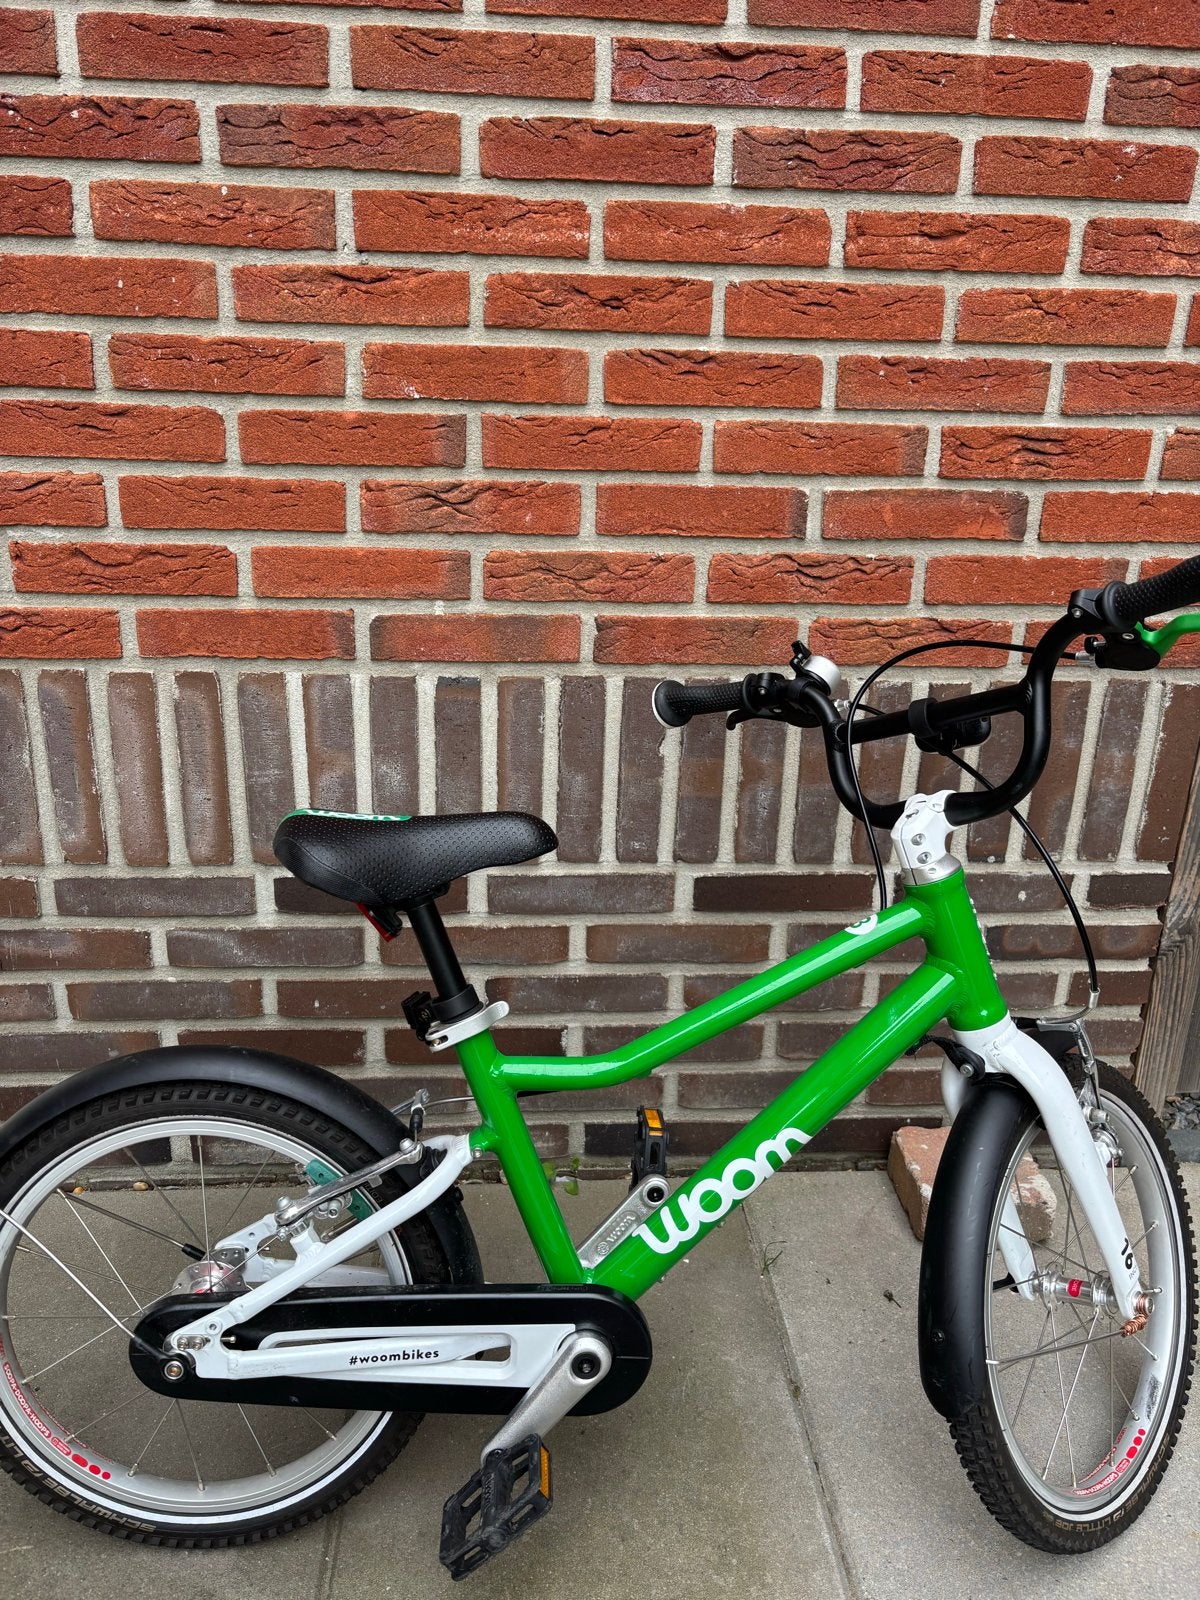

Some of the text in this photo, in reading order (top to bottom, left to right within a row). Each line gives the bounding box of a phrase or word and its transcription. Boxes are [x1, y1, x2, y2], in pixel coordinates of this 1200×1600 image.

[632, 1128, 813, 1254] woom
[1121, 1238, 1134, 1270] 16
[349, 1349, 440, 1366] #woombikes
[42, 1477, 157, 1533] SCHWALBE
[1054, 1520, 1074, 1532] JOE
[1076, 1516, 1112, 1532] LITTLE
